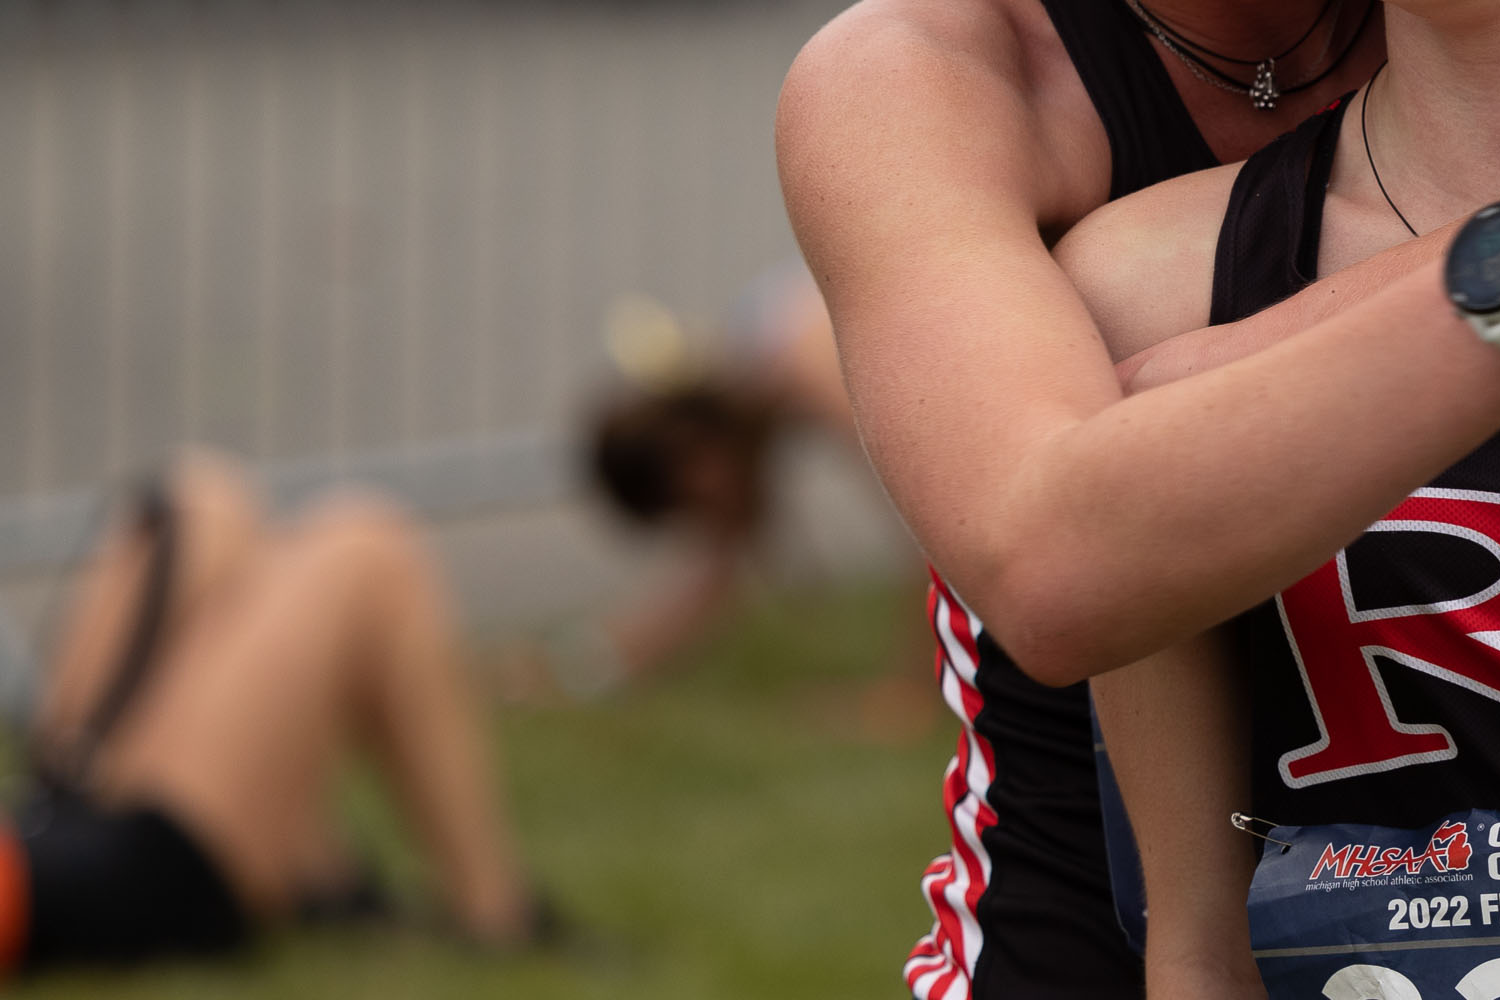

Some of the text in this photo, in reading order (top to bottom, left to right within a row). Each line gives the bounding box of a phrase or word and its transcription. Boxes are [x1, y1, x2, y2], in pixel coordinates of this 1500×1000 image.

[1309, 836, 1449, 880] MHSAA
[1305, 872, 1474, 893] michigan high school athletic association
[1388, 895, 1472, 931] 2022
